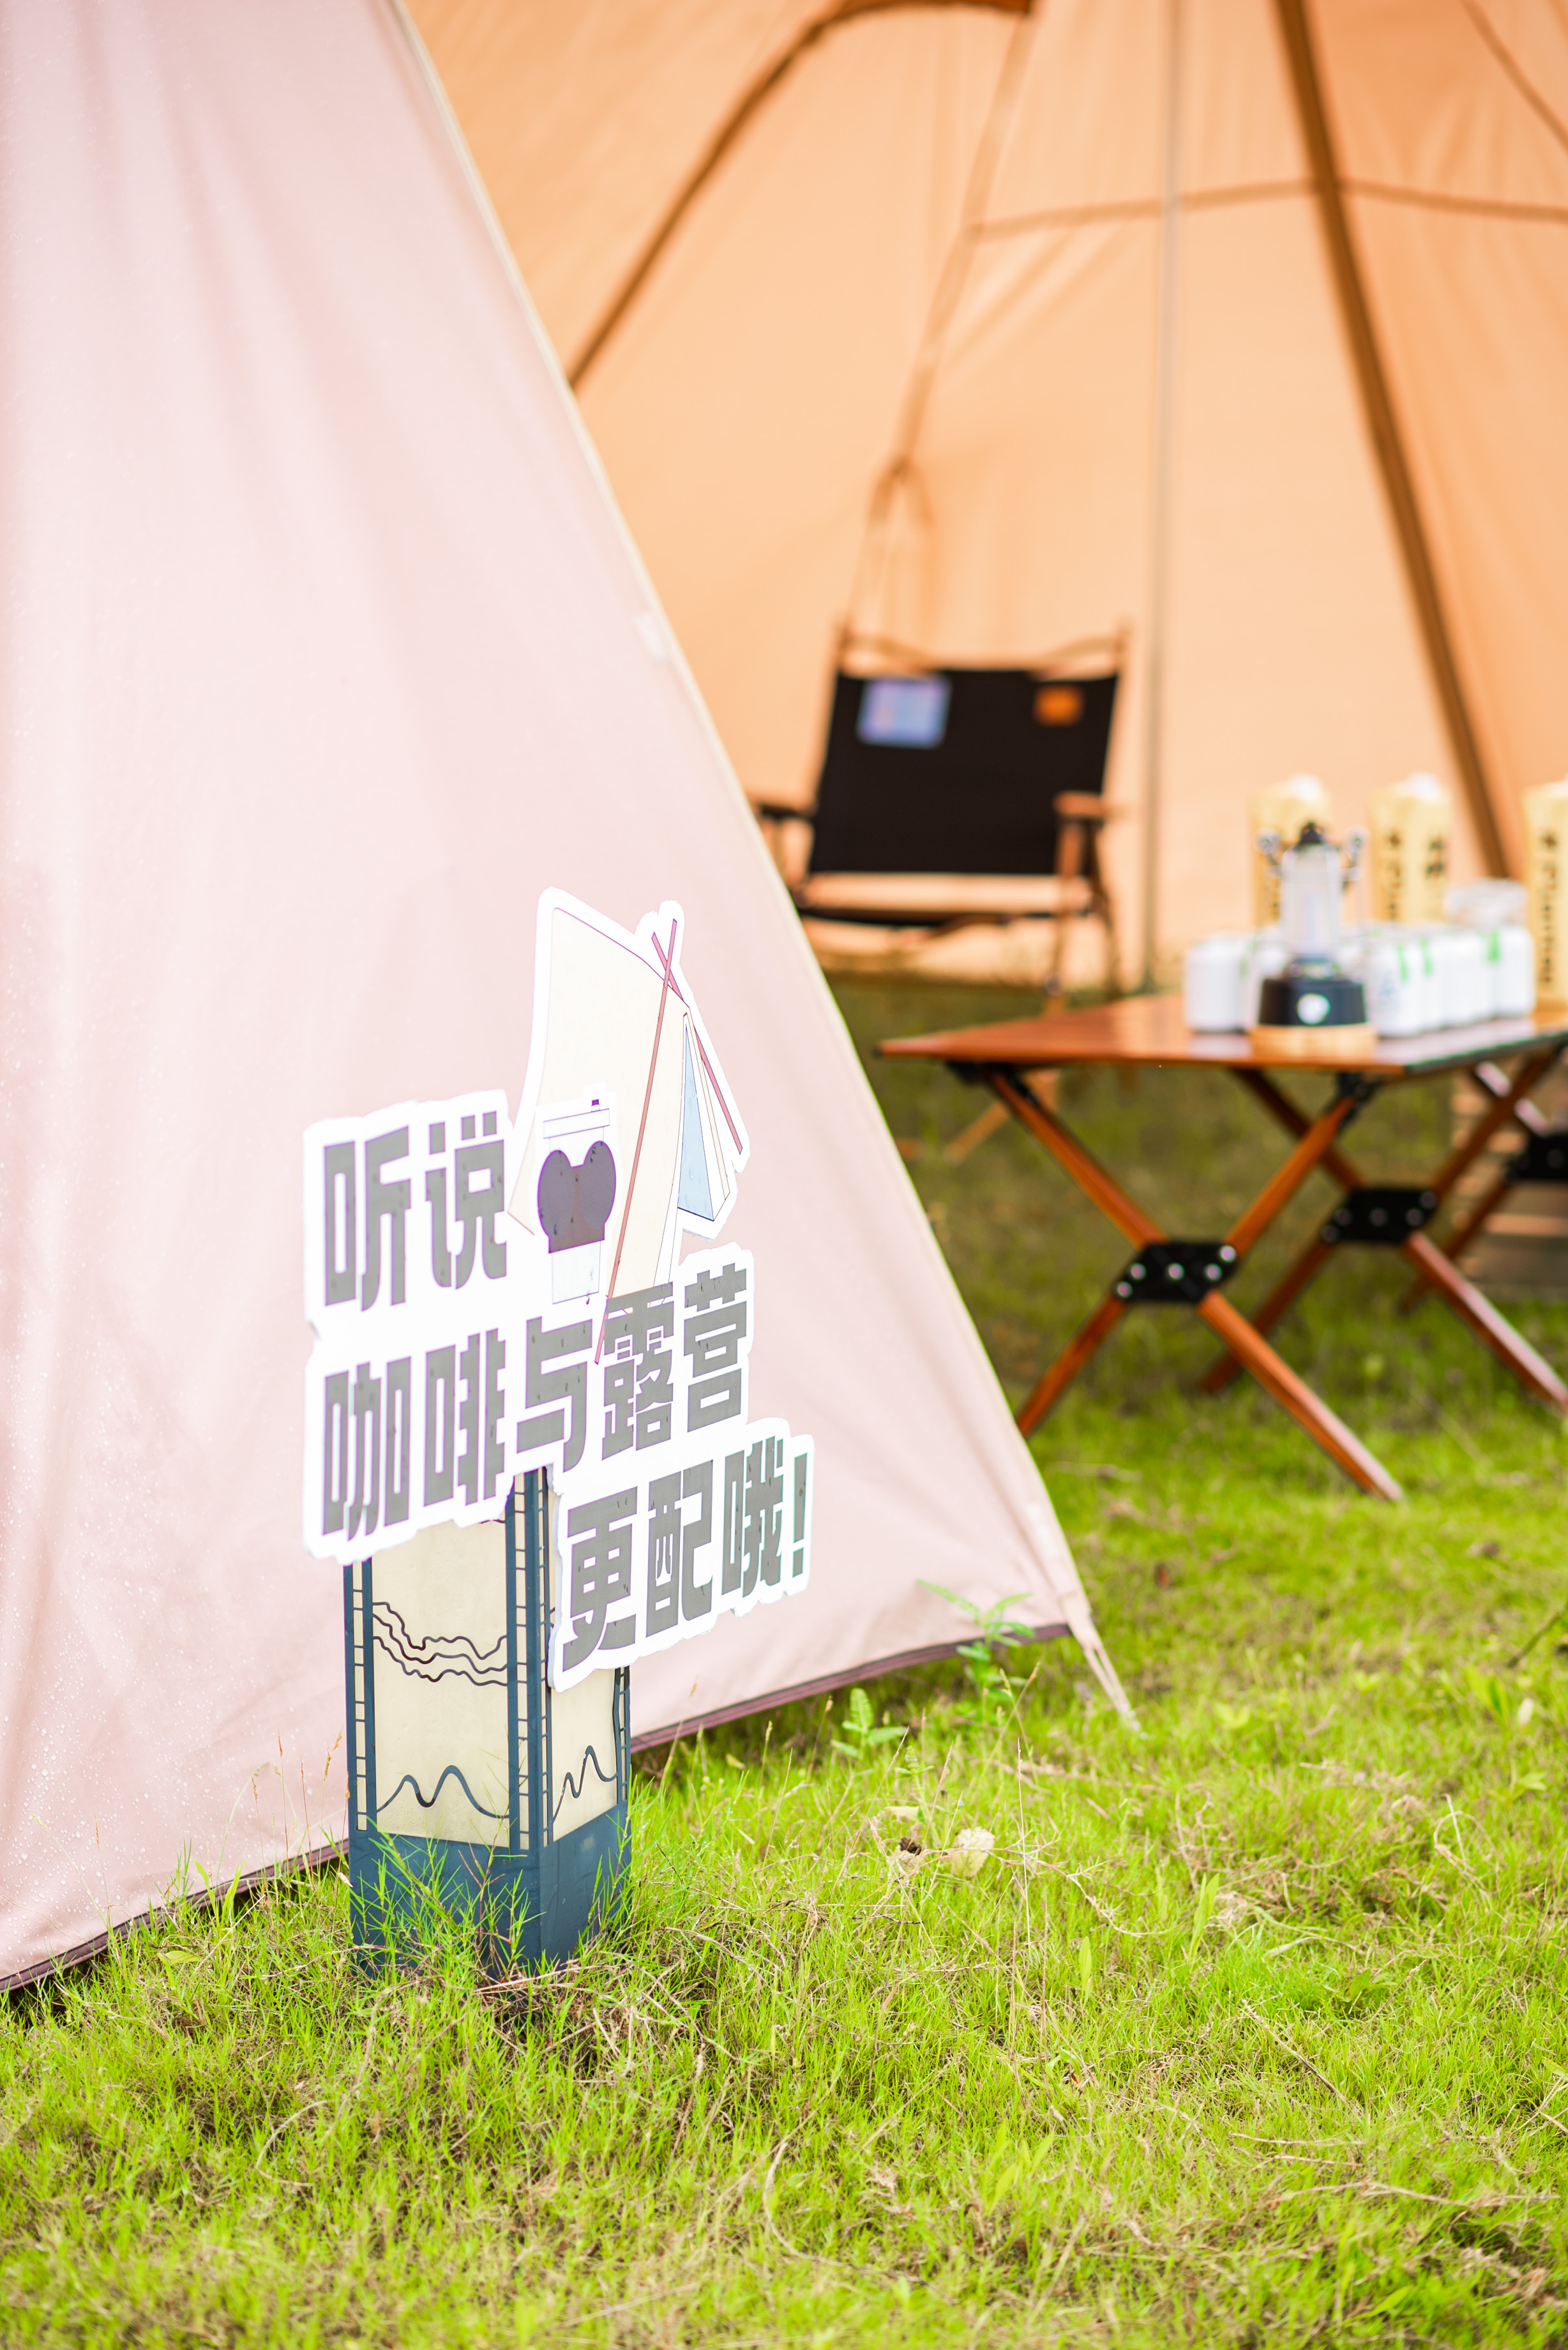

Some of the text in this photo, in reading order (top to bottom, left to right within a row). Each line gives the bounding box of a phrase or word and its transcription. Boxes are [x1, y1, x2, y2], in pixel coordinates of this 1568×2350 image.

[323, 1111, 507, 1312] 听说
[322, 1262, 748, 1541] 咖啡与露营
